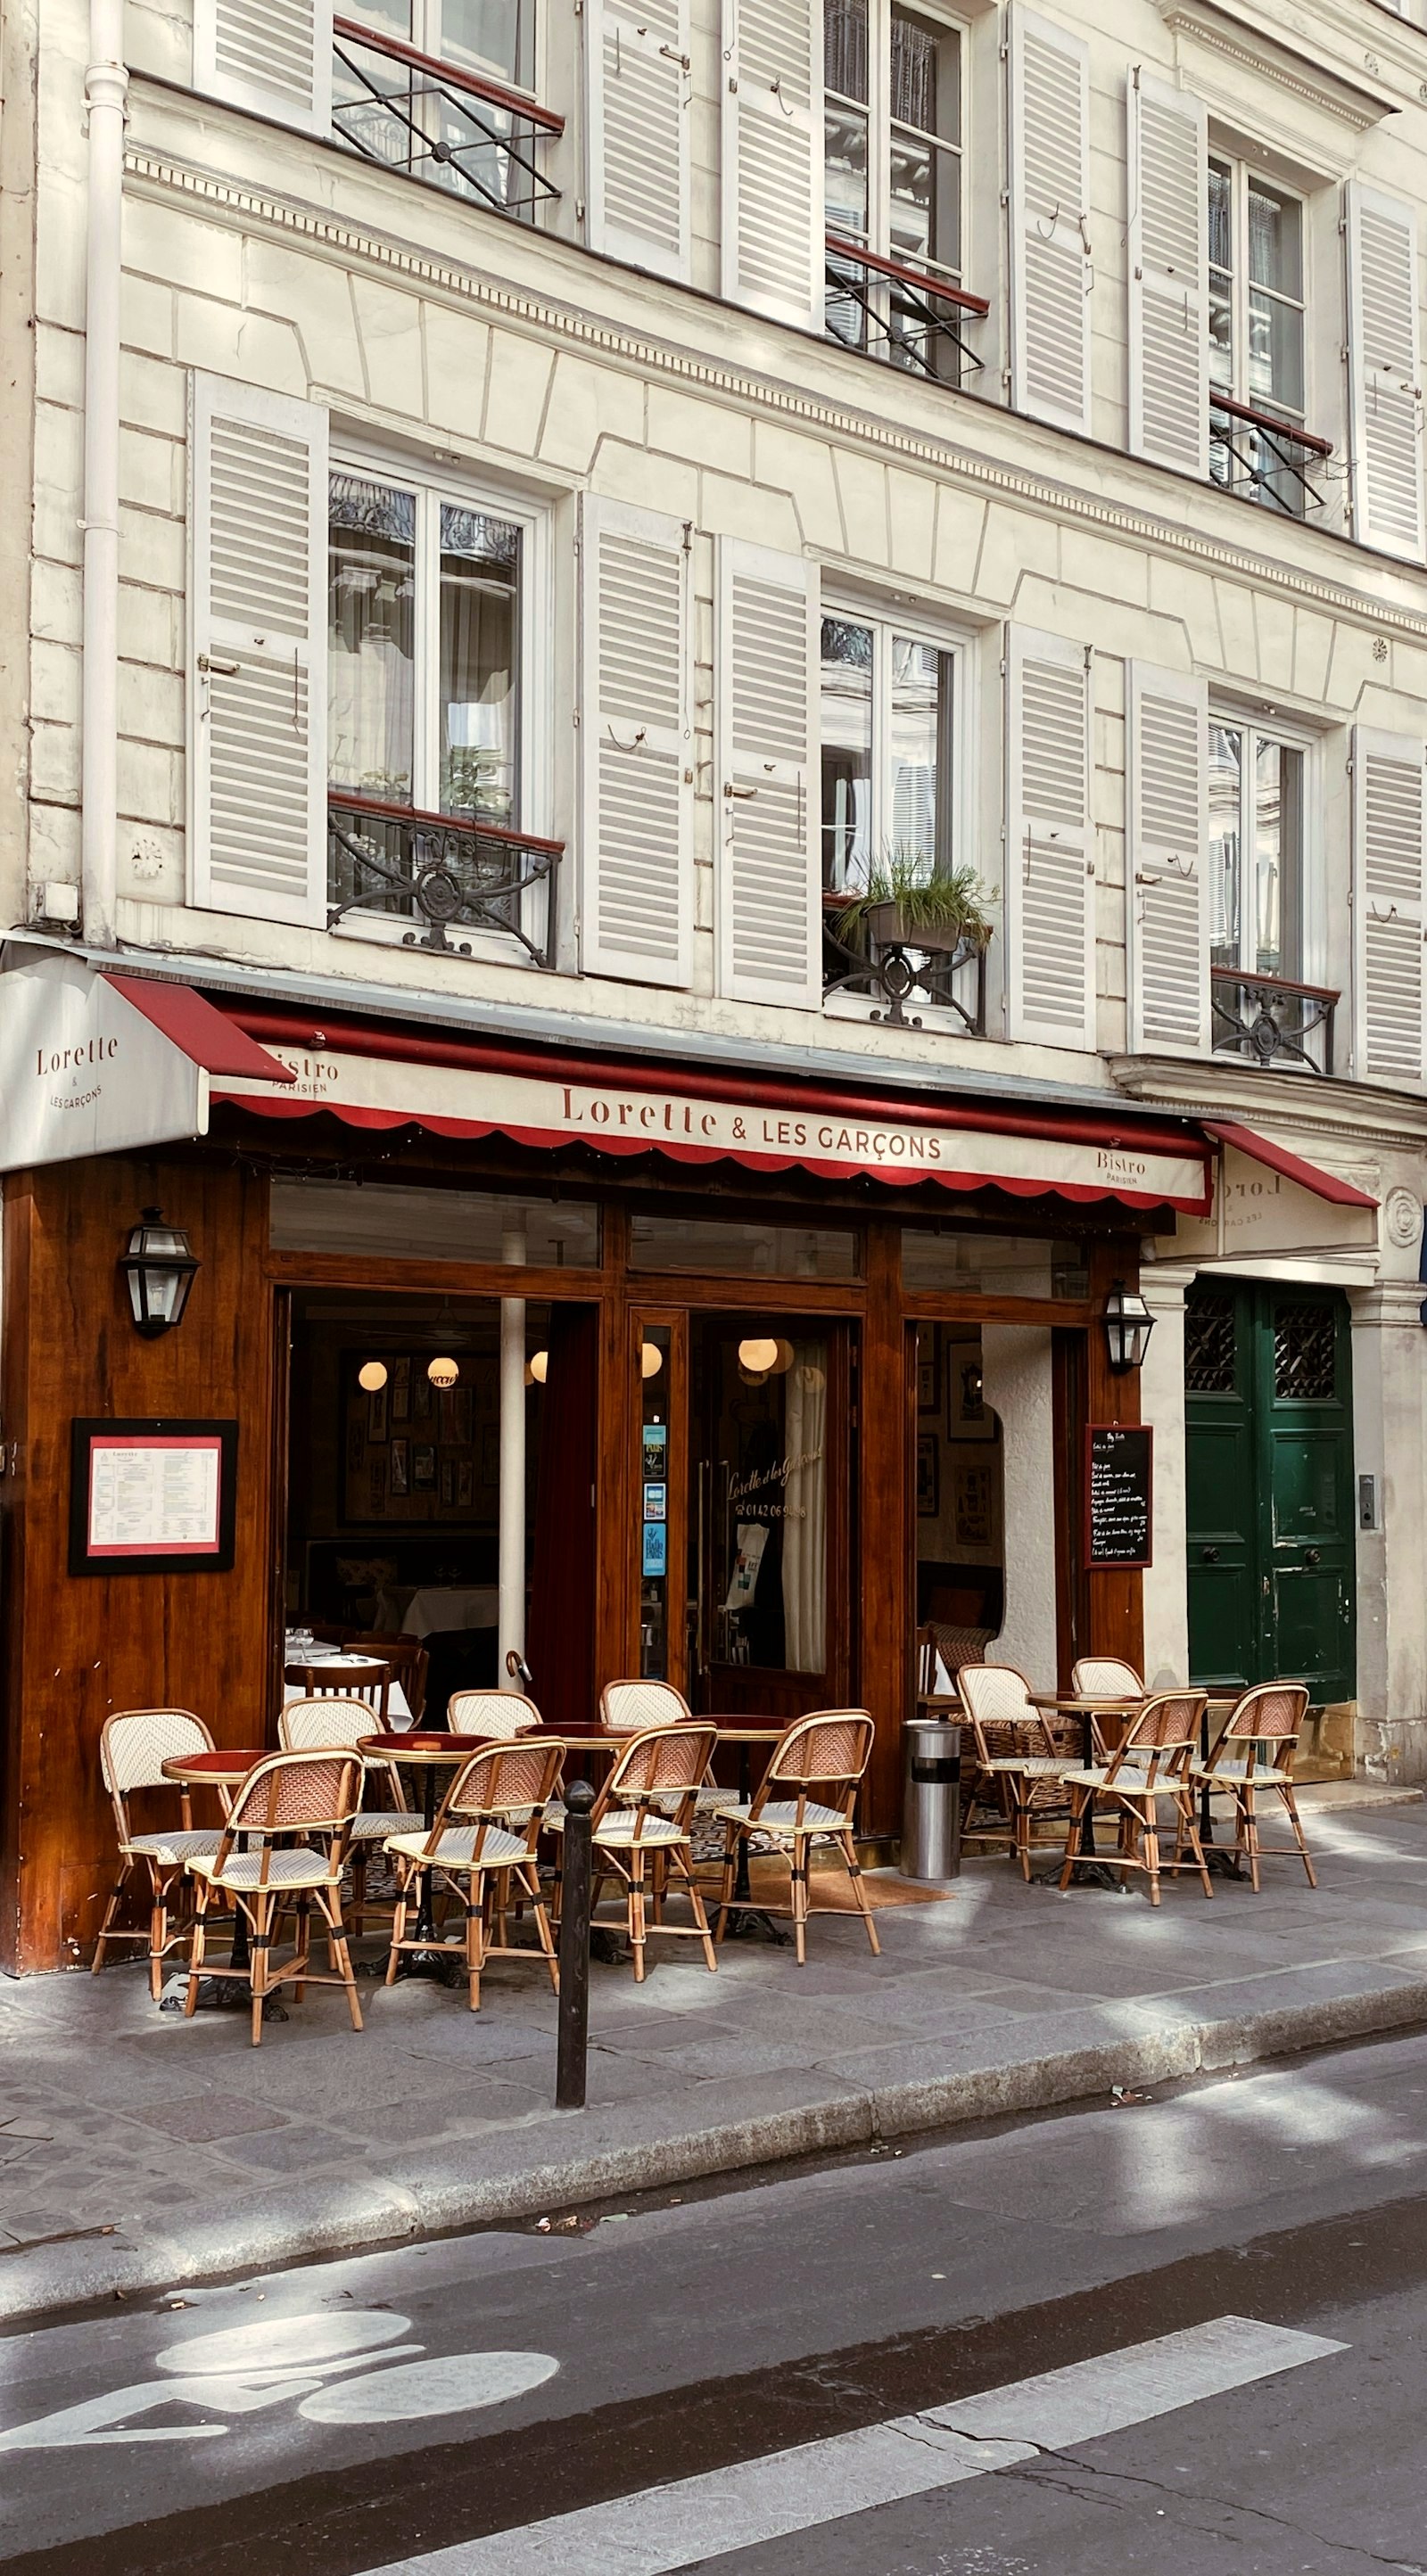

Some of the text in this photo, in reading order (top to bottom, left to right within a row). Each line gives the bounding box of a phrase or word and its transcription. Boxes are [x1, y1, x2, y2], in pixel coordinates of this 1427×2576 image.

[37, 1037, 118, 1075] Lorette
[51, 1084, 102, 1110] LES GARÇONS
[562, 1088, 941, 1161] Lorette & LES GARÇONS
[1097, 1151, 1145, 1175] Bistro
[1107, 1173, 1137, 1185] PARISIEN
